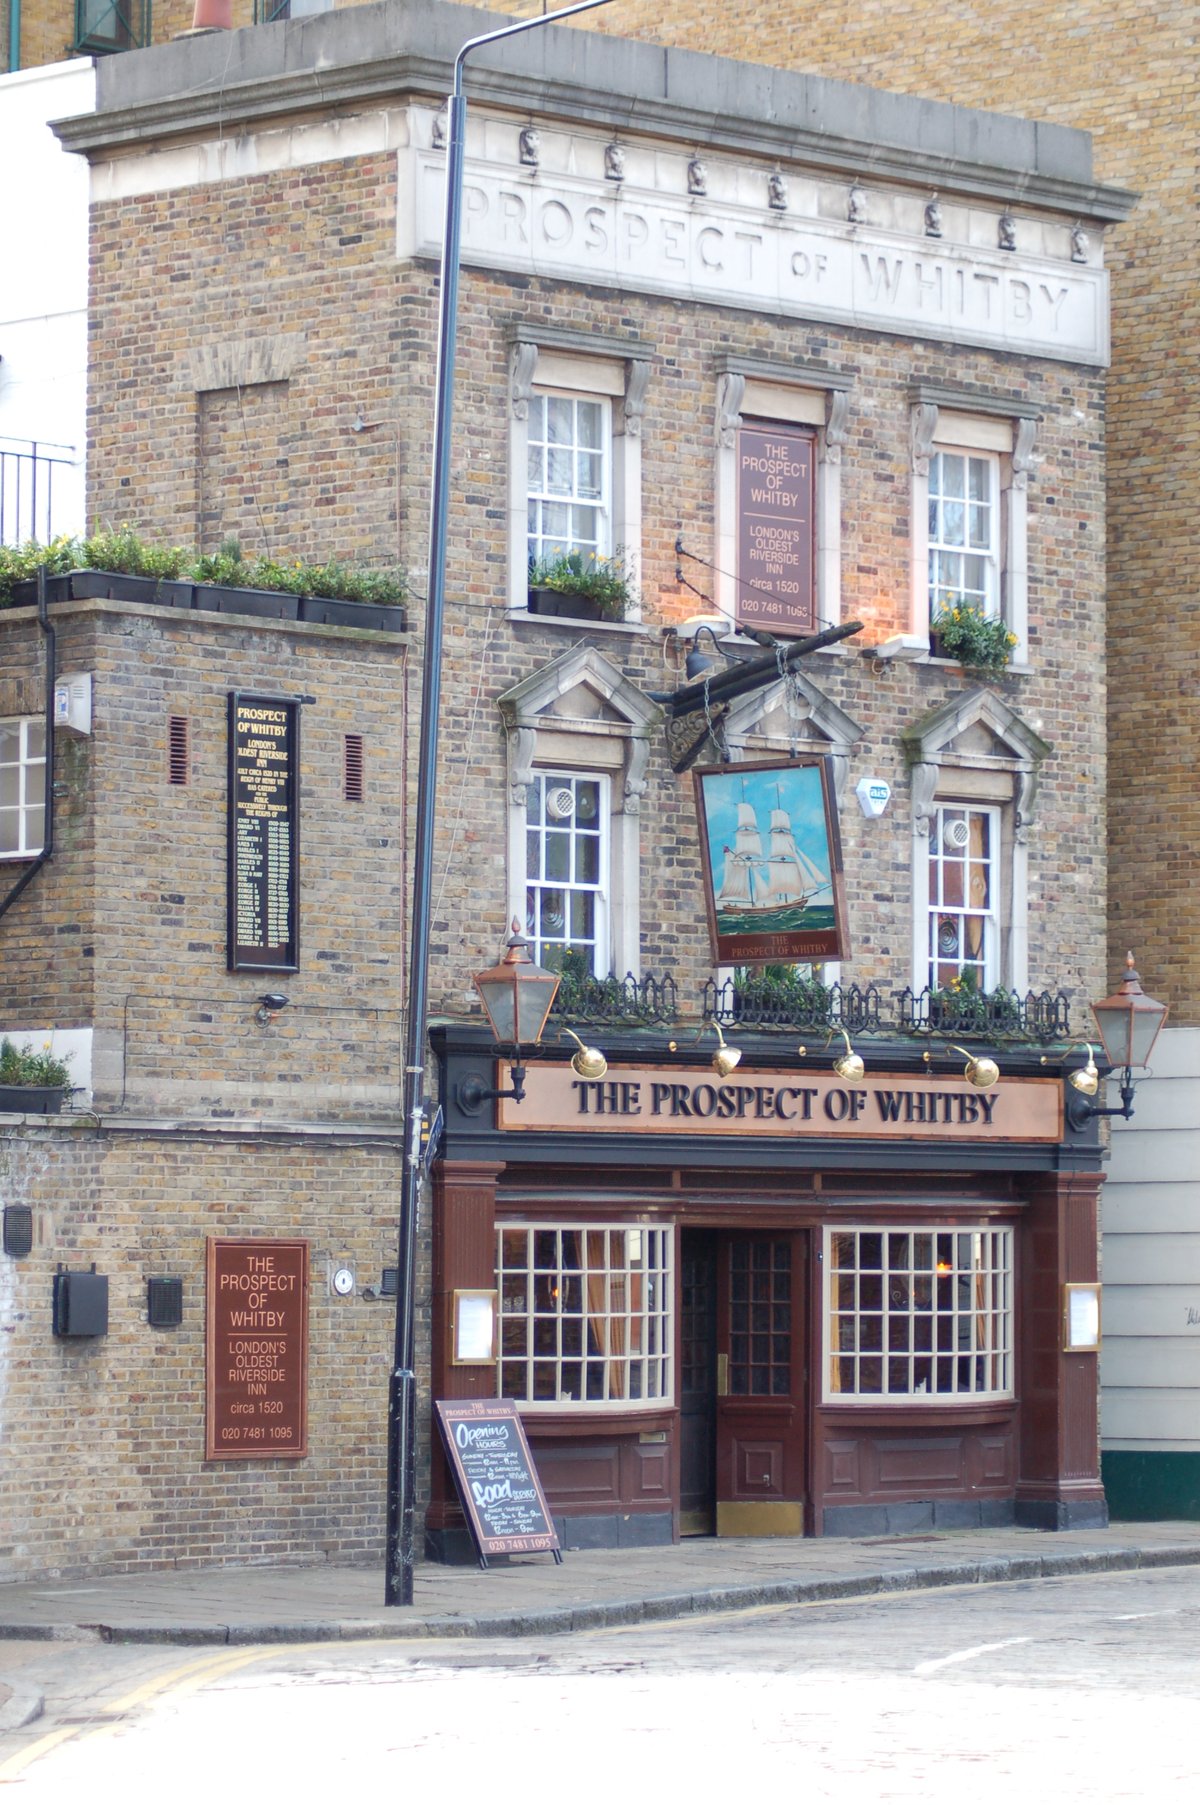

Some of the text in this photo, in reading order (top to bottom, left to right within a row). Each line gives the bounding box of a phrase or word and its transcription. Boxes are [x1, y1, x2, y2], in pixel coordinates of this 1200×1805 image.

[462, 184, 1069, 332] PROSPECT OF WHITBY
[764, 444, 789, 460] THE
[742, 456, 807, 478] PROSPECT
[766, 474, 783, 490] OF
[751, 488, 798, 508] WHITBY
[750, 526, 800, 542] LONDON'S
[755, 538, 793, 552] OLDEST
[749, 548, 799, 565] RIVERSIDE
[766, 563, 783, 574] INN
[749, 577, 799, 593] circa 1520
[742, 600, 758, 612] 020
[762, 602, 782, 614] 7481
[237, 707, 287, 722] PROSPECT
[238, 722, 287, 736] OF WHITBY
[248, 739, 276, 750] LONDON'S
[259, 750, 288, 760] RIVERSIDE
[770, 936, 789, 945] THE
[732, 944, 828, 957] PROSPECT OF WHITBY
[572, 1080, 1000, 1125] THE PROSPECT OF WHITBY
[246, 1257, 274, 1272] THE
[220, 1274, 296, 1291] PROSPECT
[248, 1292, 268, 1309] OF
[230, 1311, 285, 1327] WHITBY
[229, 1341, 286, 1354] LONDON'S
[236, 1355, 278, 1368] OLDEST
[229, 1369, 286, 1381] RIVERSIDE
[247, 1383, 267, 1395] INN
[230, 1401, 283, 1414] circa 1520
[222, 1427, 292, 1439] 020 7481 1095
[456, 1424, 509, 1448] Opening
[489, 1538, 551, 1551] 020 7481 1095
